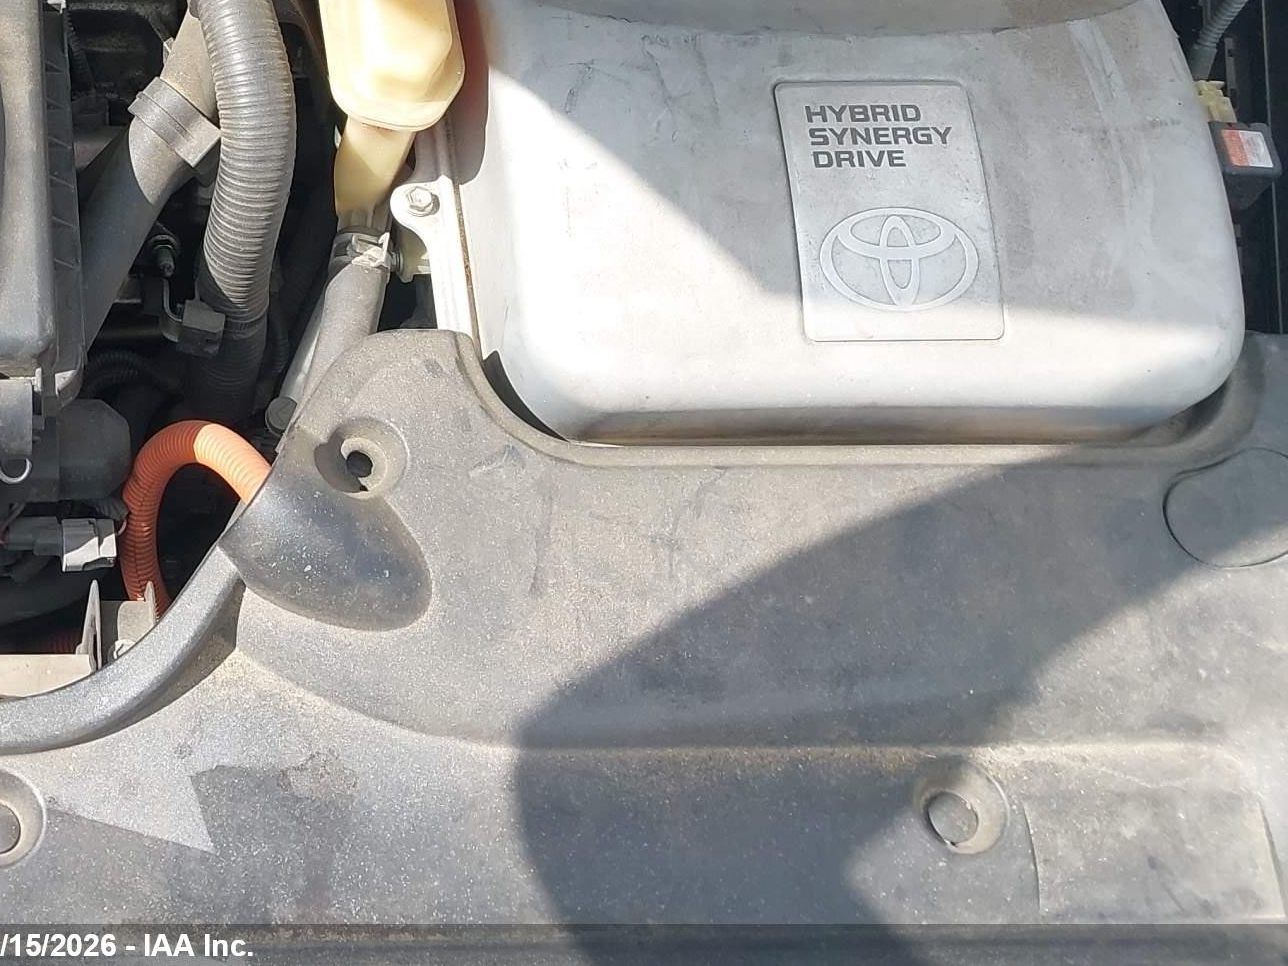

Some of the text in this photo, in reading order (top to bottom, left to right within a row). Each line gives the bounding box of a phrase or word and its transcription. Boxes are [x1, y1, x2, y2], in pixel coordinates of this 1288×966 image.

[805, 104, 922, 123] HYBRID
[809, 127, 953, 146] SYNERGY
[813, 150, 907, 168] DRIVE
